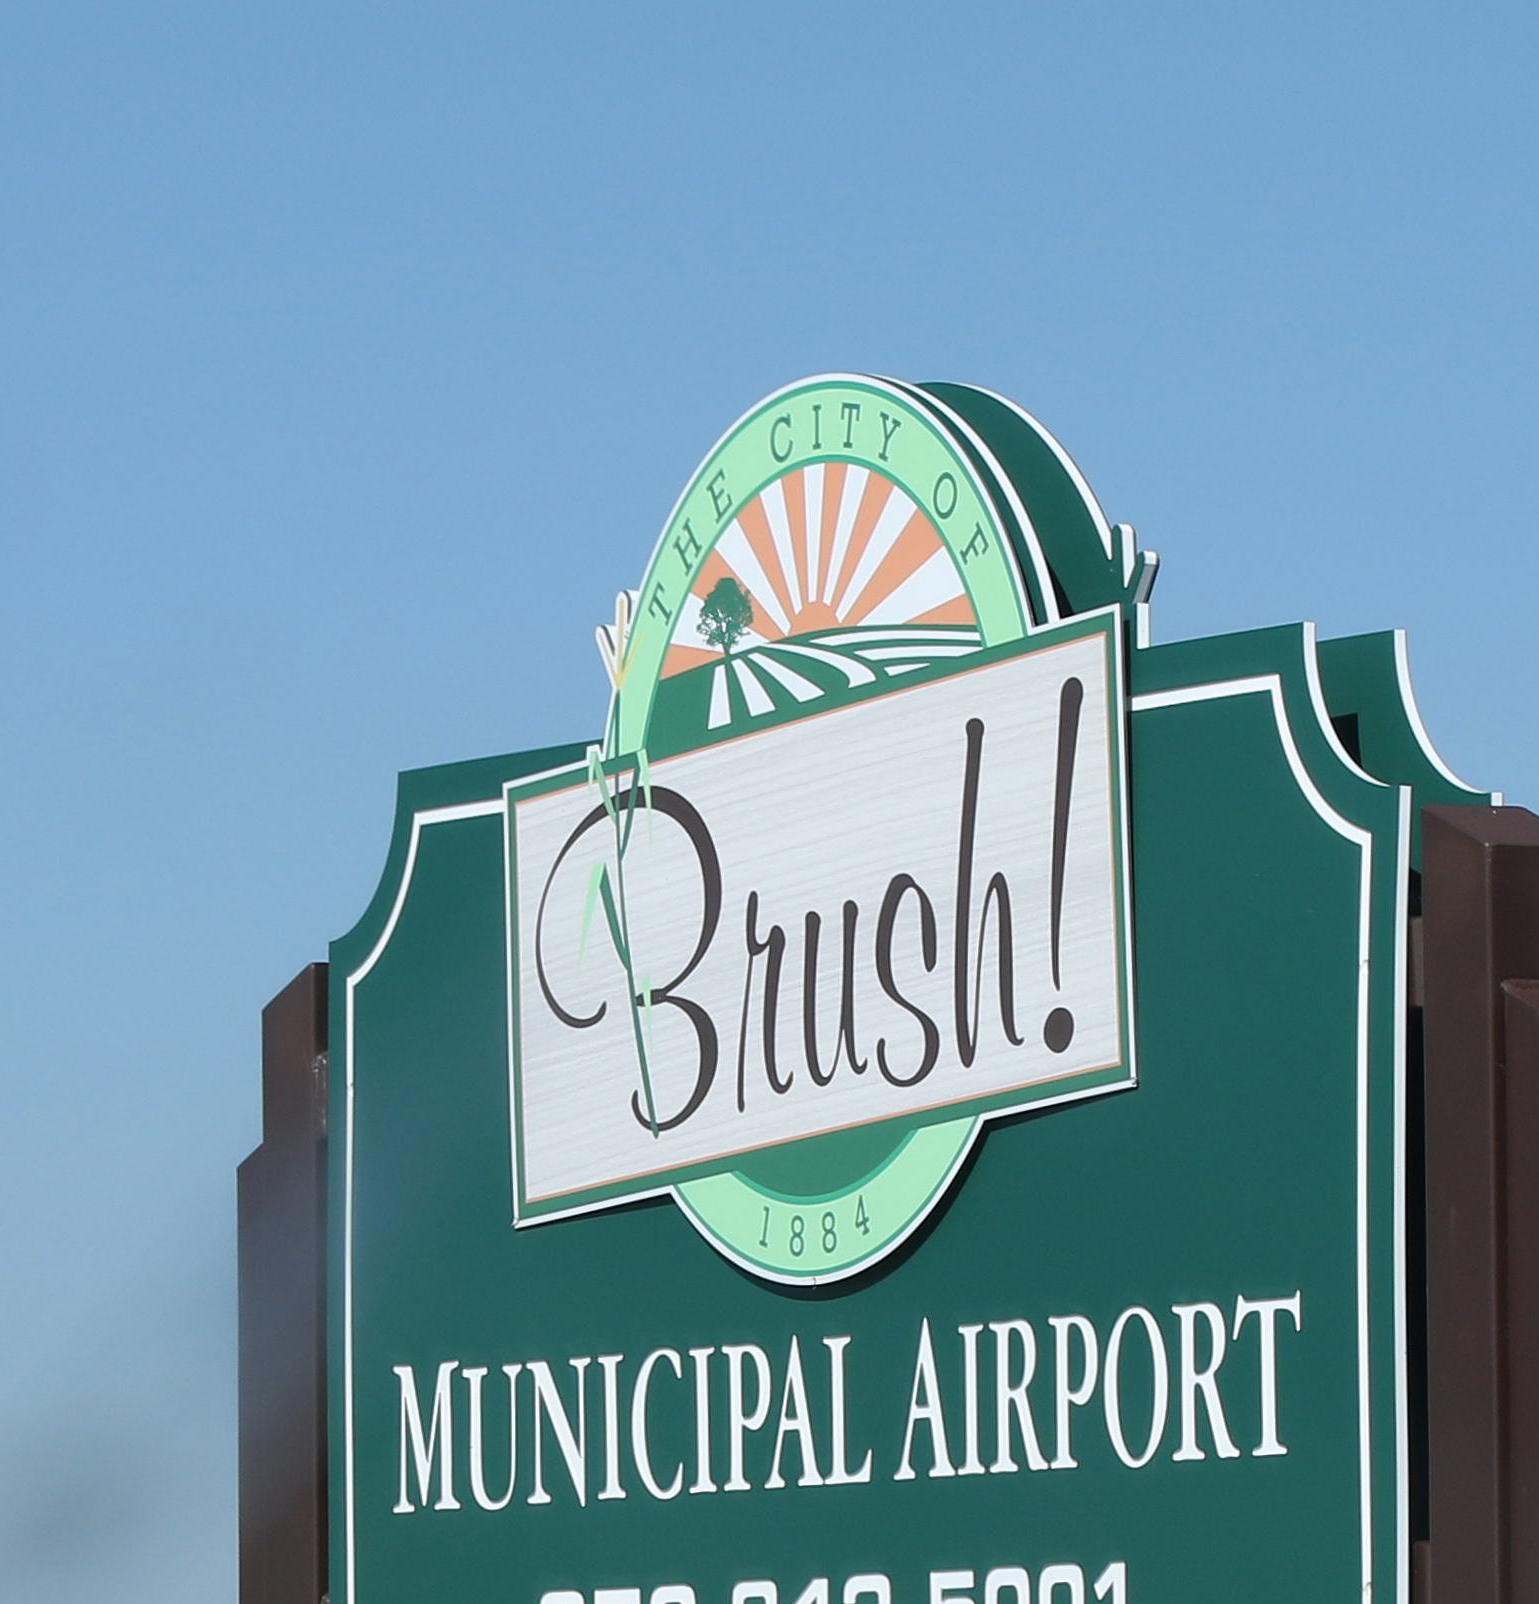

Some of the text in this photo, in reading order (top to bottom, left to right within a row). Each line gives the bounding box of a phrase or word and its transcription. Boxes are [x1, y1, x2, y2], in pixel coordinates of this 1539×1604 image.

[648, 402, 990, 629] THE CITY OF
[535, 676, 1084, 1133] Brush!
[759, 1193, 870, 1257] 1884
[392, 1289, 1302, 1515] MUNICIPAL AIRPORT
